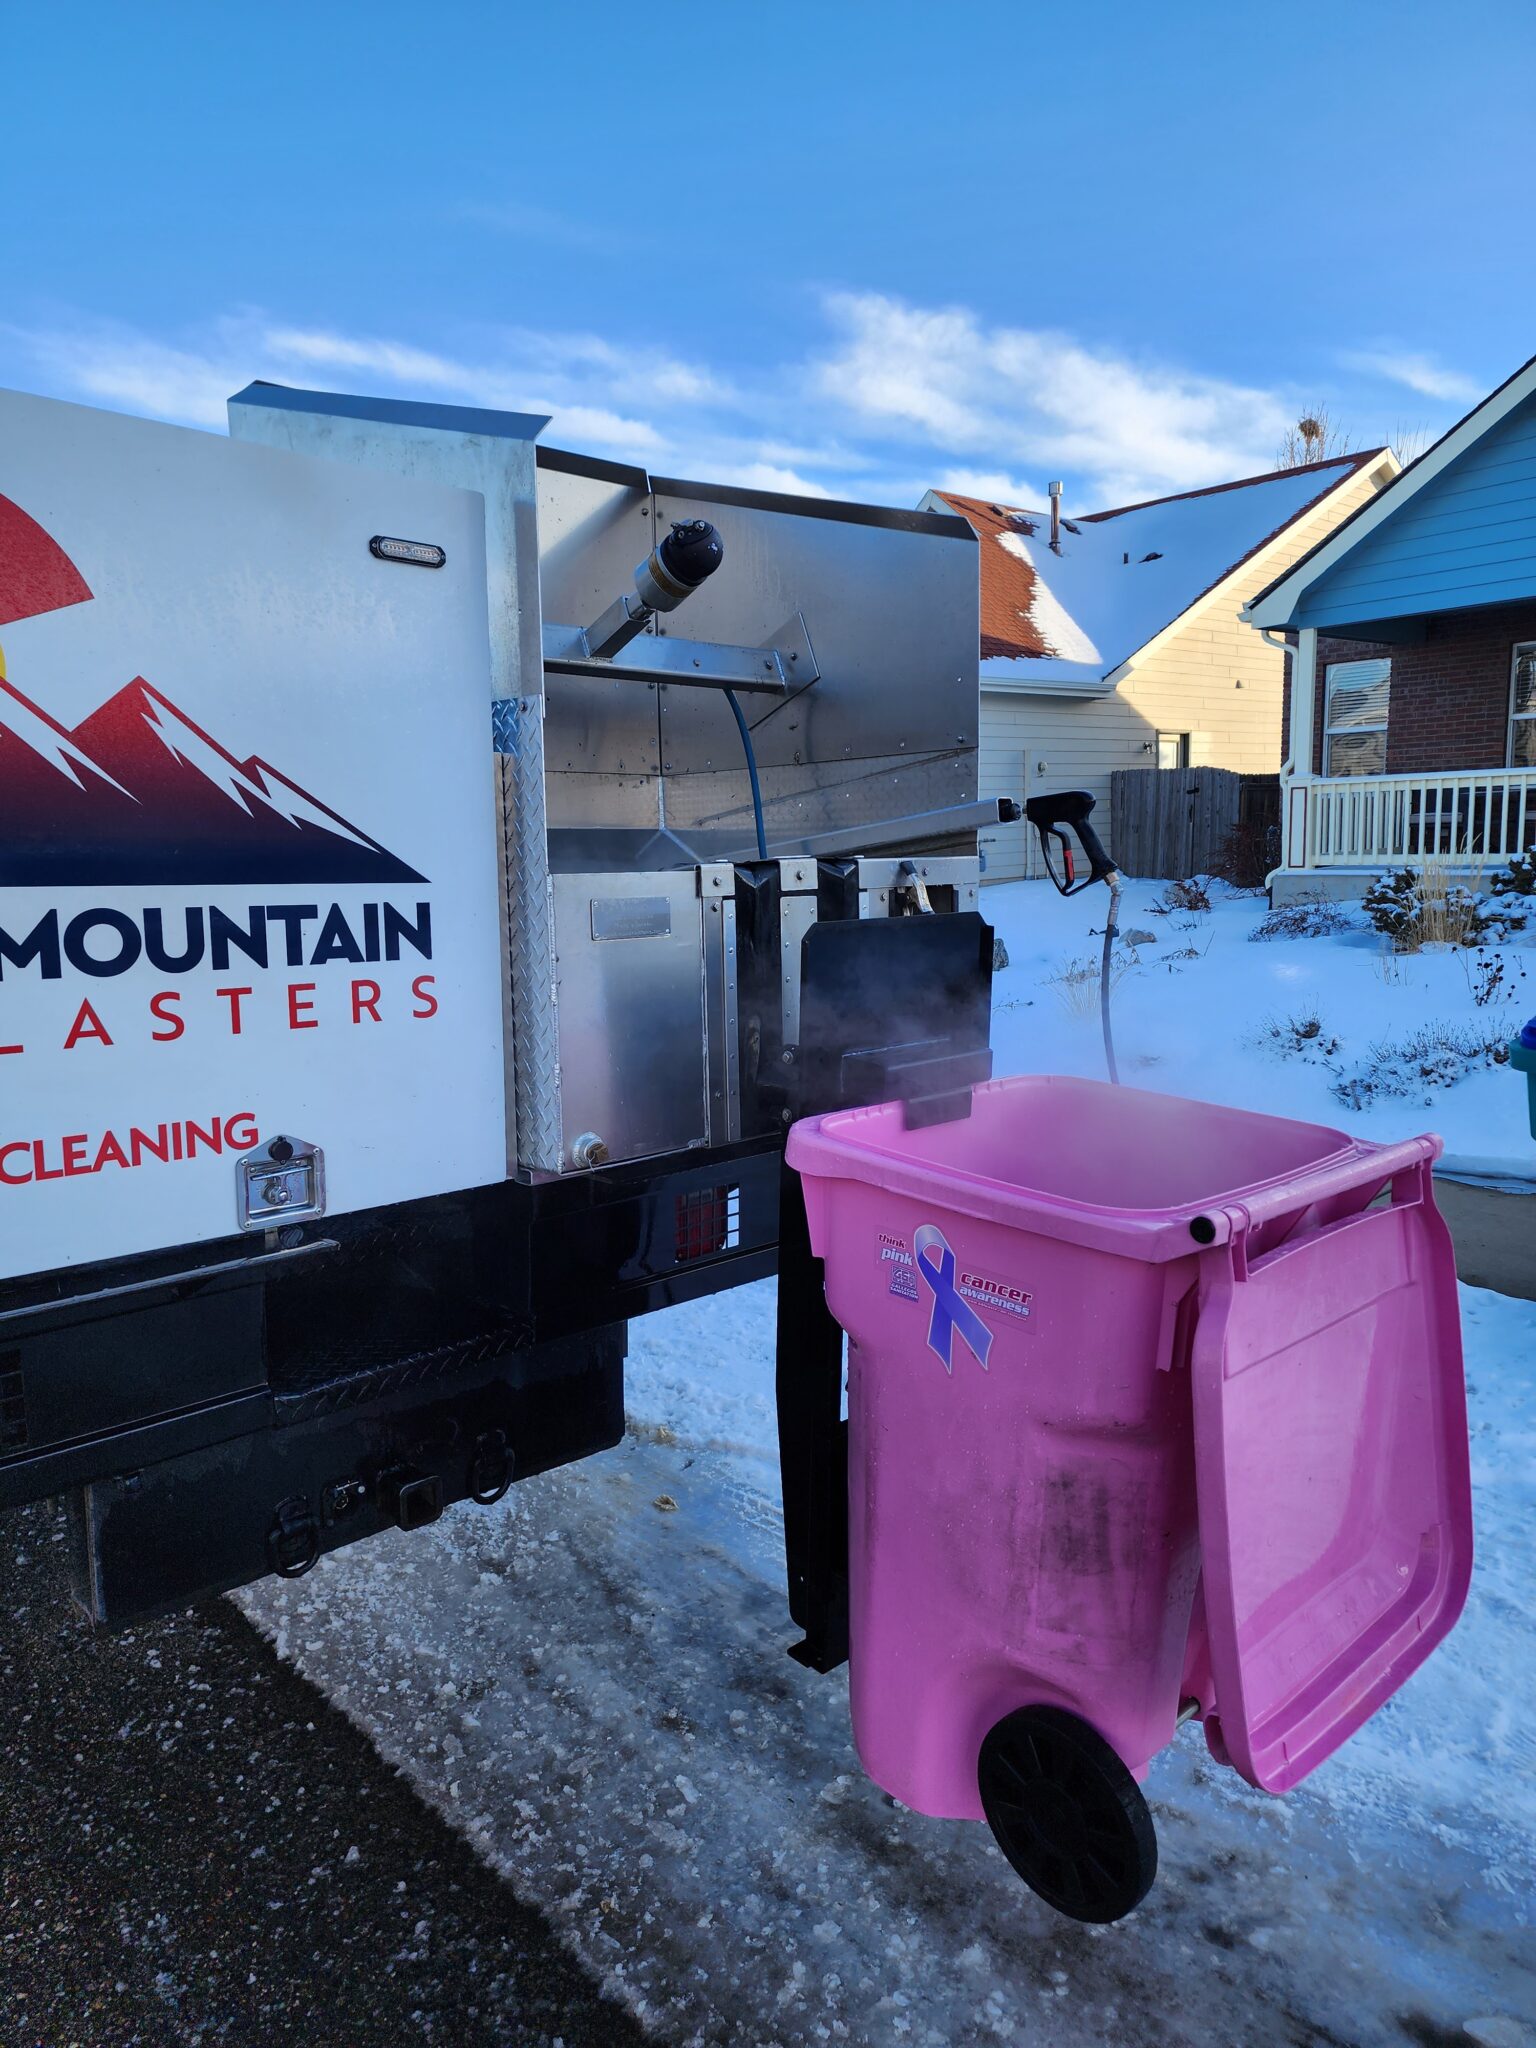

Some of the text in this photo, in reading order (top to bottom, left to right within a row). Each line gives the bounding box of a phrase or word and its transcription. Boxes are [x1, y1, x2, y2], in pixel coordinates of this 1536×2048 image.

[0, 901, 433, 982] MOUNTAIN
[0, 1112, 260, 1185] CLEANING
[878, 1233, 906, 1249] think
[881, 1247, 913, 1266] pink
[959, 1286, 1031, 1316] awareness
[960, 1272, 1032, 1304] cancer
